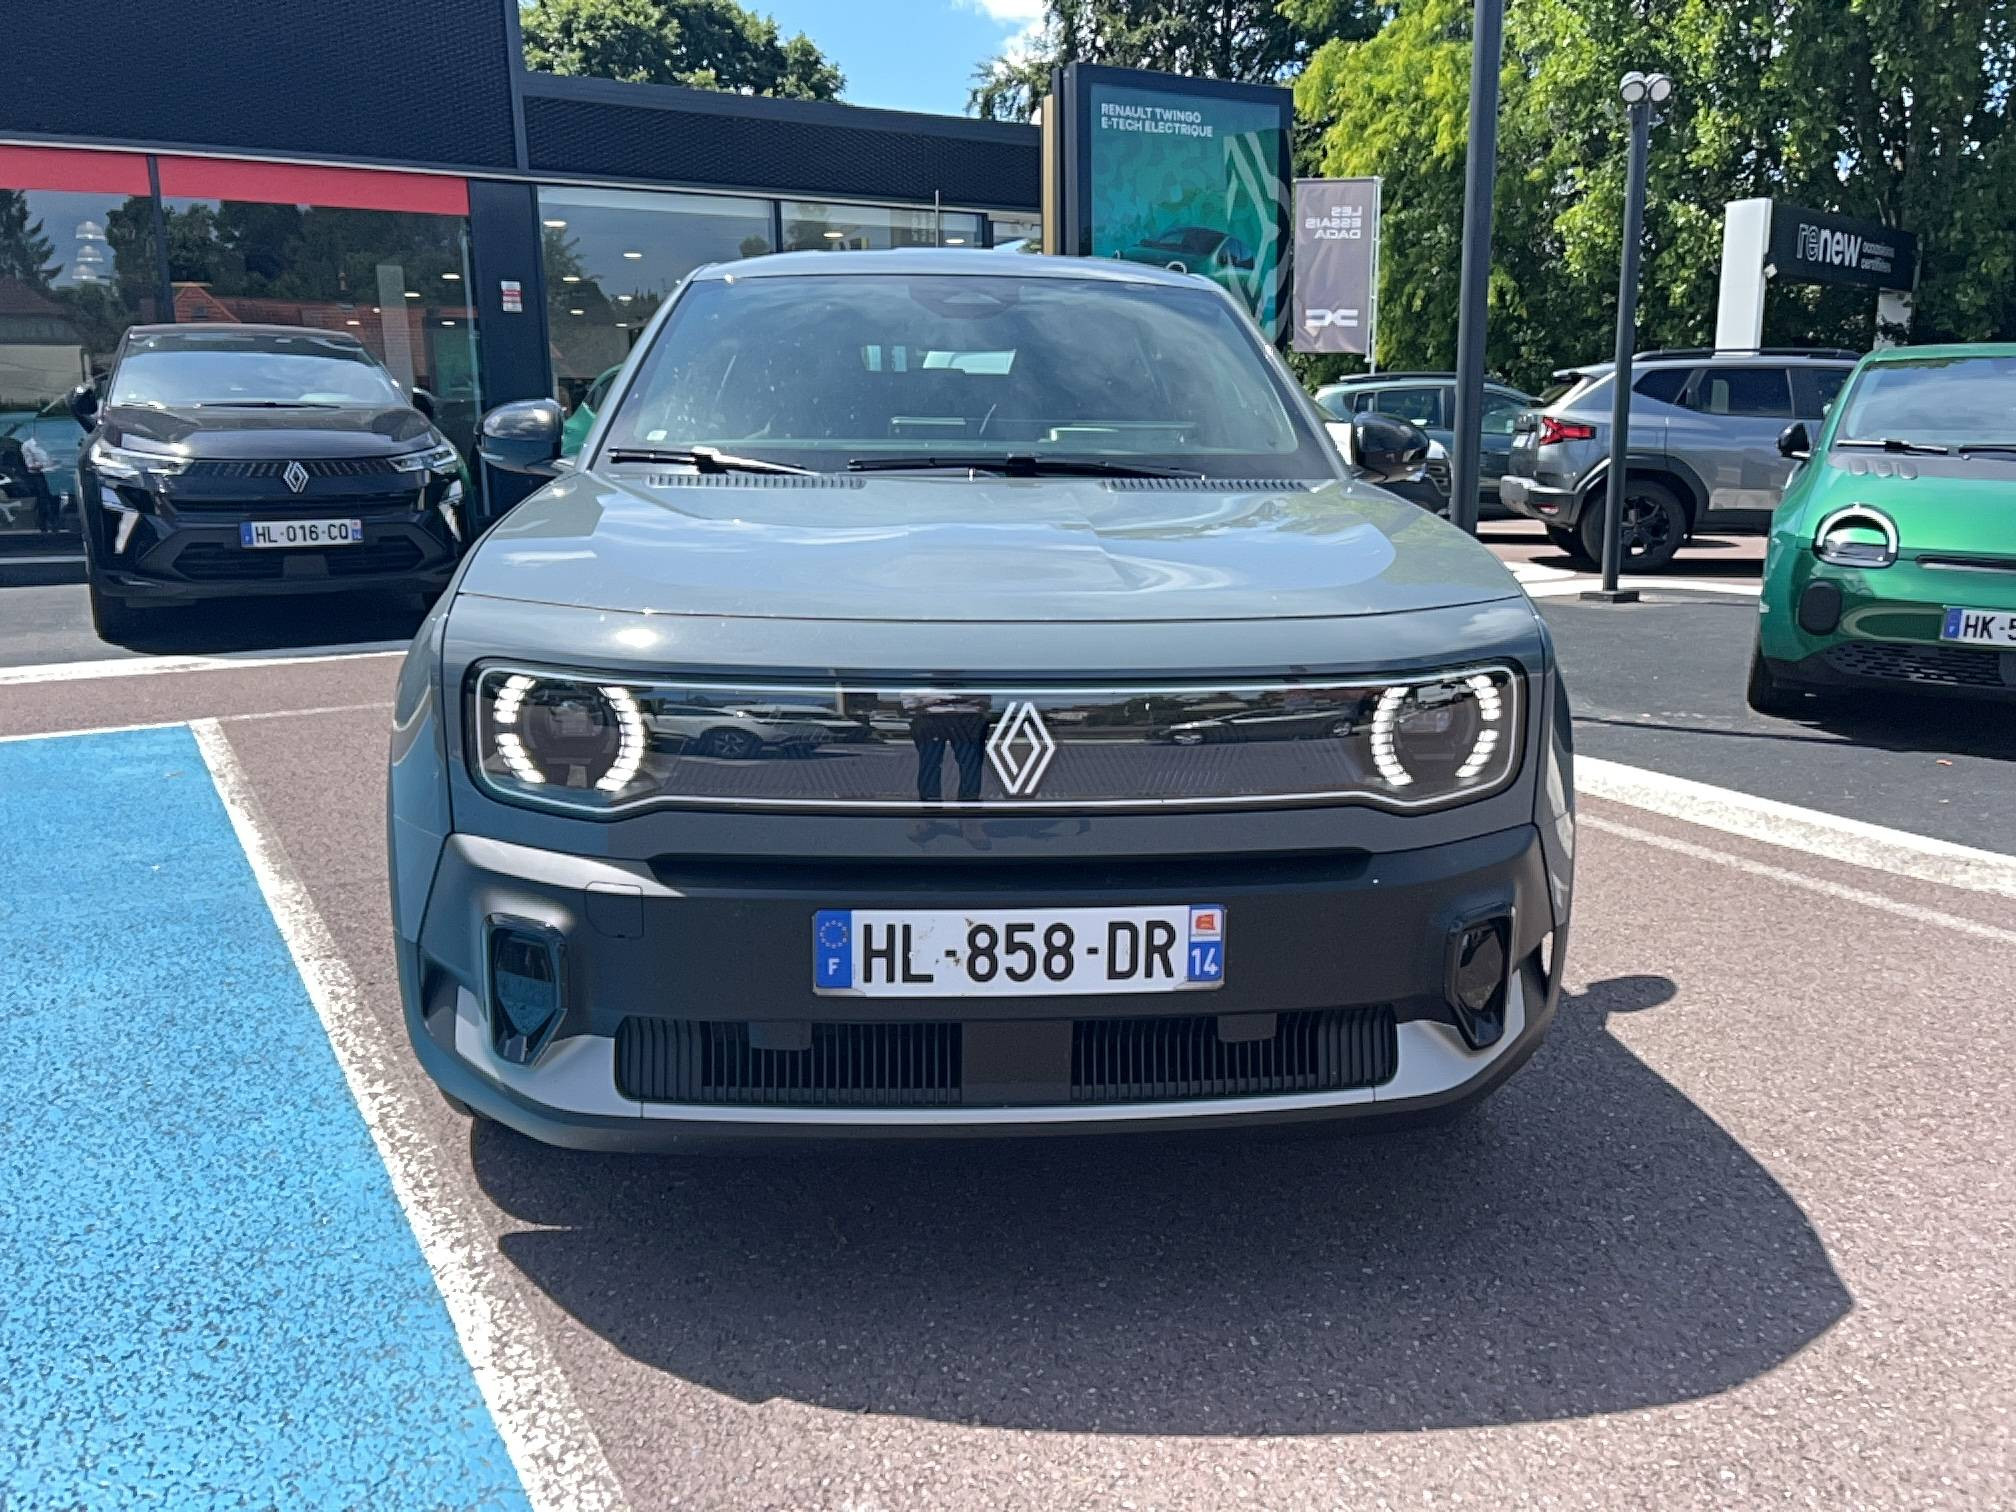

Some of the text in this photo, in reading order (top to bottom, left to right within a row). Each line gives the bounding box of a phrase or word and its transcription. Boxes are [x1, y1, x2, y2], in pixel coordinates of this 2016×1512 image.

[1101, 103, 1201, 123] RENAULT TWINGO
[1101, 116, 1213, 138] E-TECH ELECTRIQUE
[1796, 223, 1861, 268] renew
[863, 919, 1177, 983] HL-858-DR
[1191, 947, 1220, 976] 14
[828, 958, 840, 976] F
